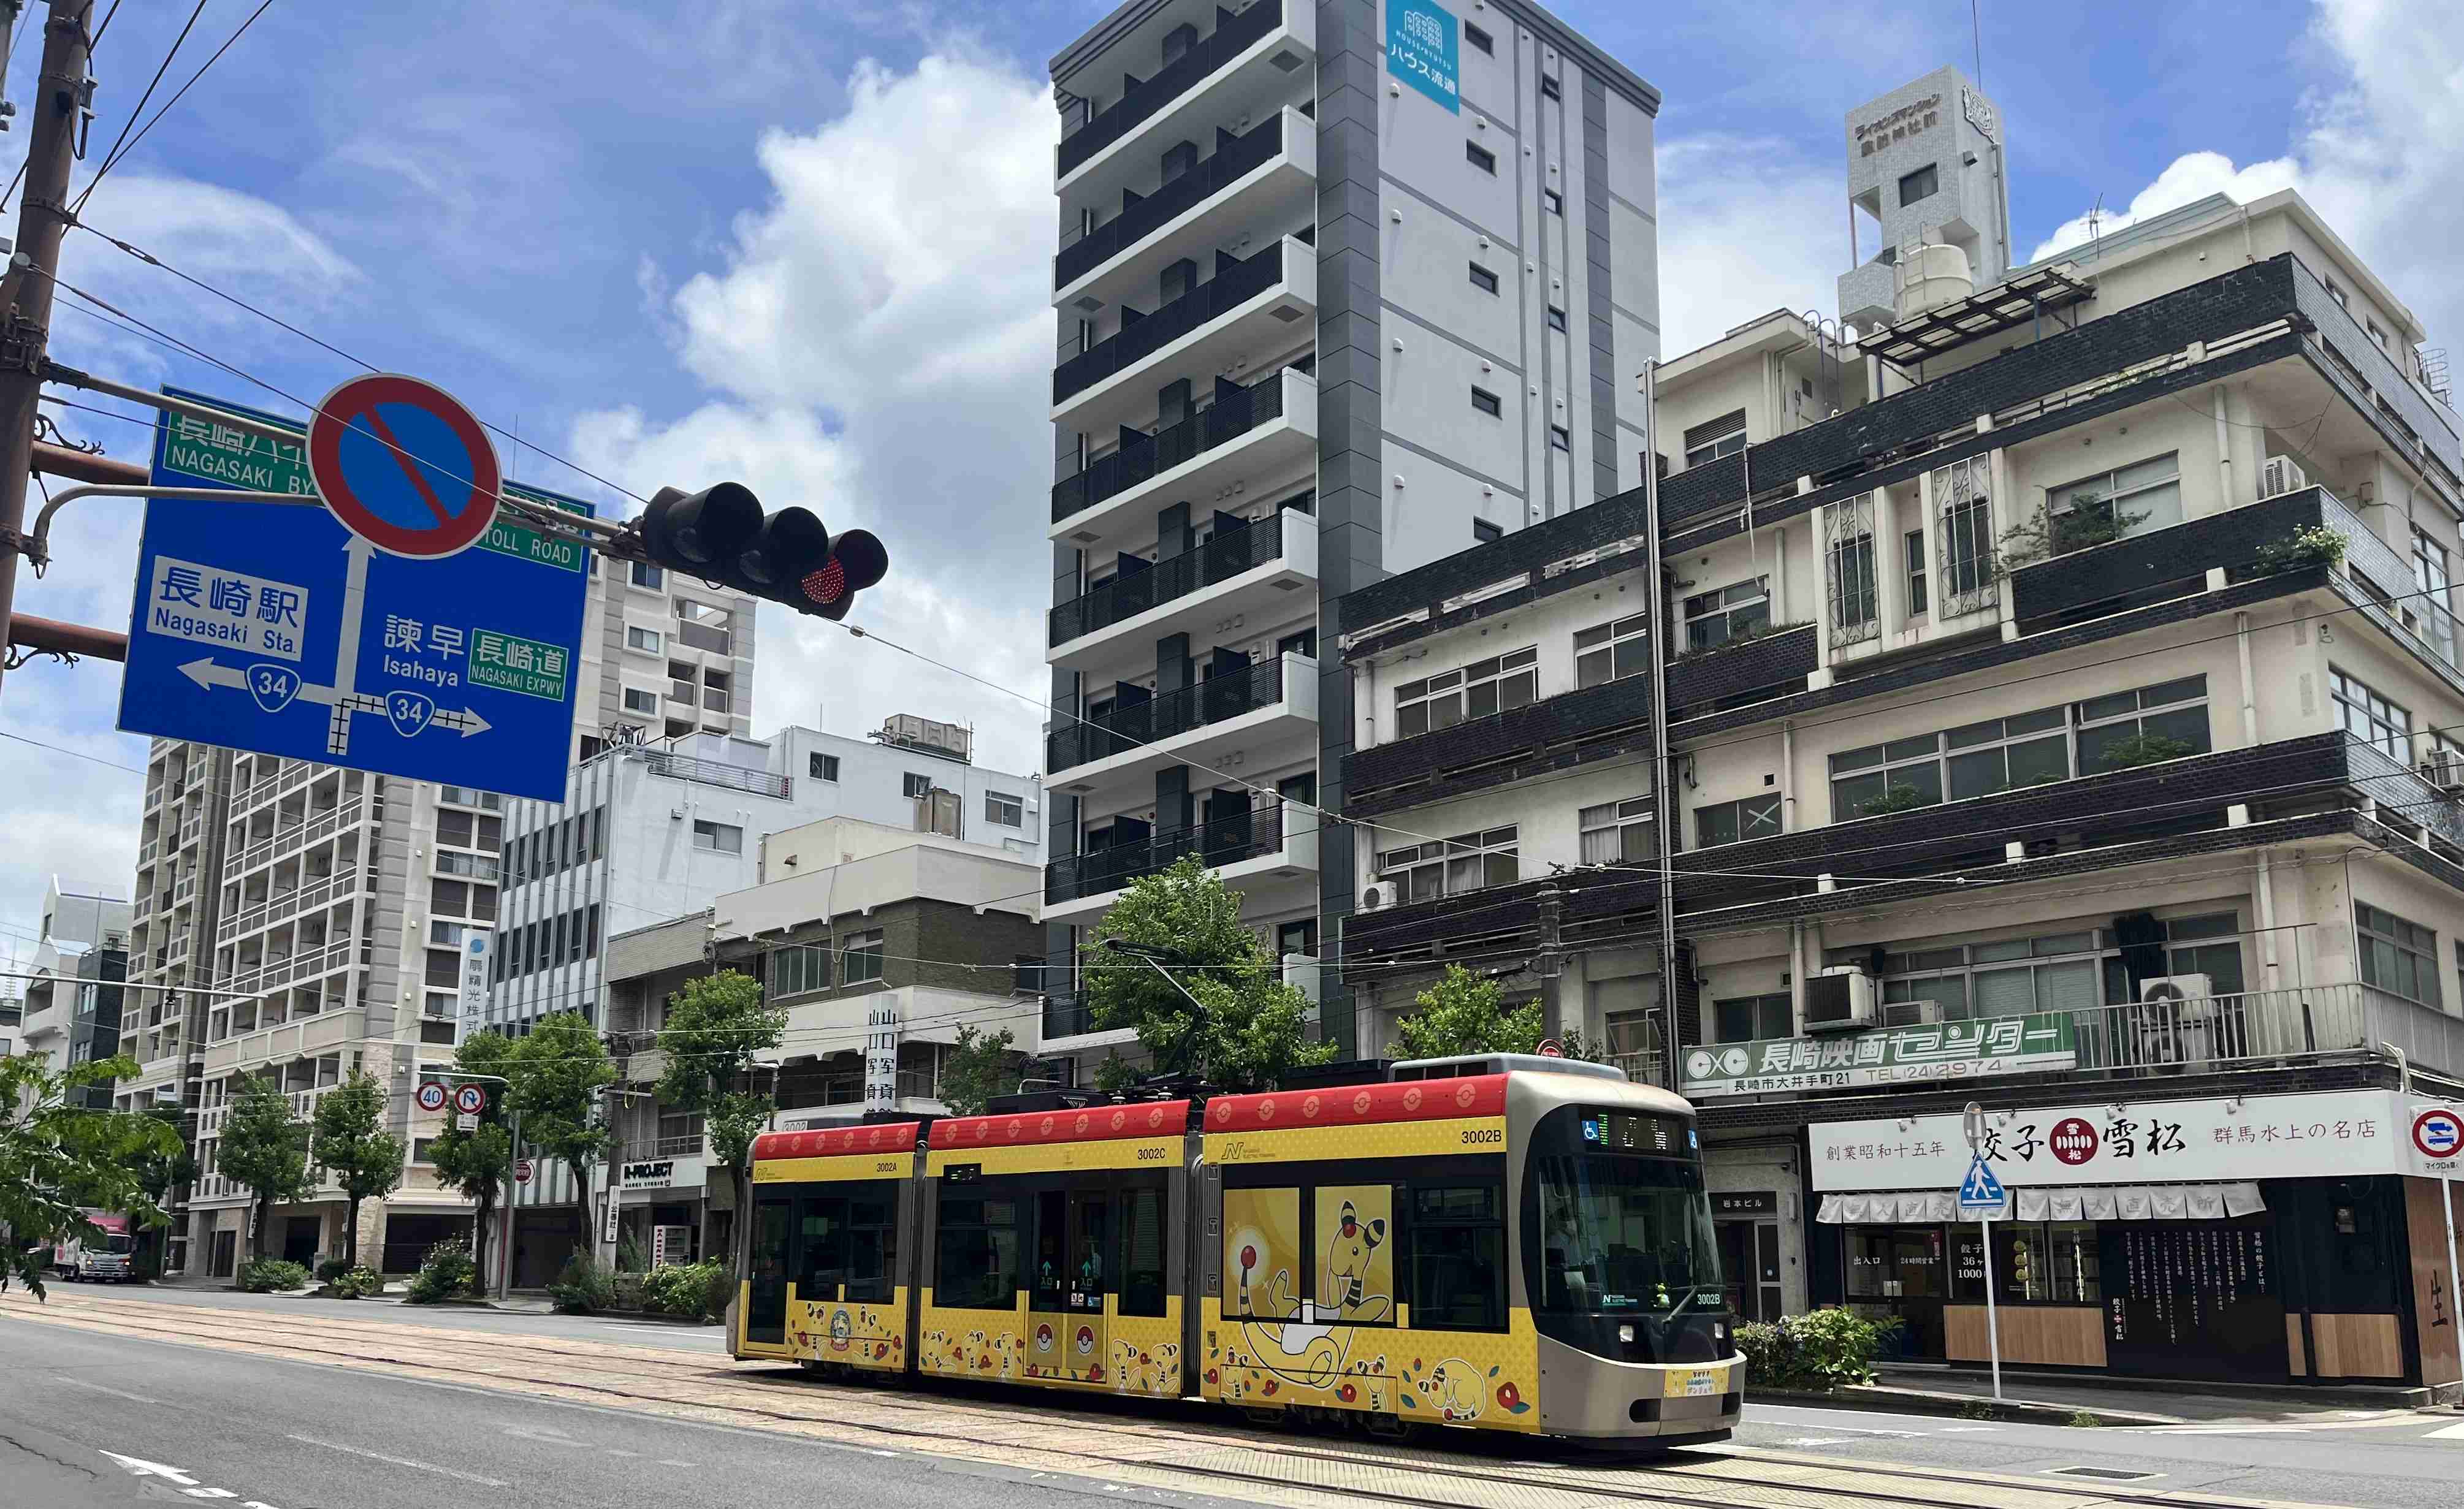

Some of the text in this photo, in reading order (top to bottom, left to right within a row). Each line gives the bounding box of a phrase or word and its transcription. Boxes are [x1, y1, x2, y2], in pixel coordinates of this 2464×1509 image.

[171, 445, 273, 488] NAGASAKI
[530, 539, 571, 564] ROAD
[159, 566, 299, 629] 長崎駅
[154, 607, 297, 655] Nagasaki Sta.
[383, 614, 465, 661] 諫早
[476, 634, 564, 679] 長崎道
[383, 653, 459, 688] Isahaya
[471, 664, 563, 697] NAGASAKI EXPWY
[257, 671, 288, 698] 34
[395, 697, 423, 724] 34
[1758, 1019, 2058, 1074] 長崎映画センター
[866, 1009, 879, 1113] 山口写真
[880, 1008, 896, 1113] 山口写真
[423, 1090, 441, 1104] 40
[1461, 1130, 1502, 1144] 3002B
[2102, 1118, 2186, 1158] 雪松
[2212, 1119, 2377, 1145] 群馬水上の名店
[1137, 1147, 1166, 1160] 3002C
[1825, 1141, 1945, 1161] 創業昭和十五年
[2069, 1149, 2082, 1161] 松
[876, 1162, 898, 1173] 3002A
[1853, 1256, 1881, 1266] 出入口
[1961, 1244, 1984, 1254] 餃子
[1958, 1269, 1986, 1279] 1000
[1697, 1293, 1721, 1305] 3002B
